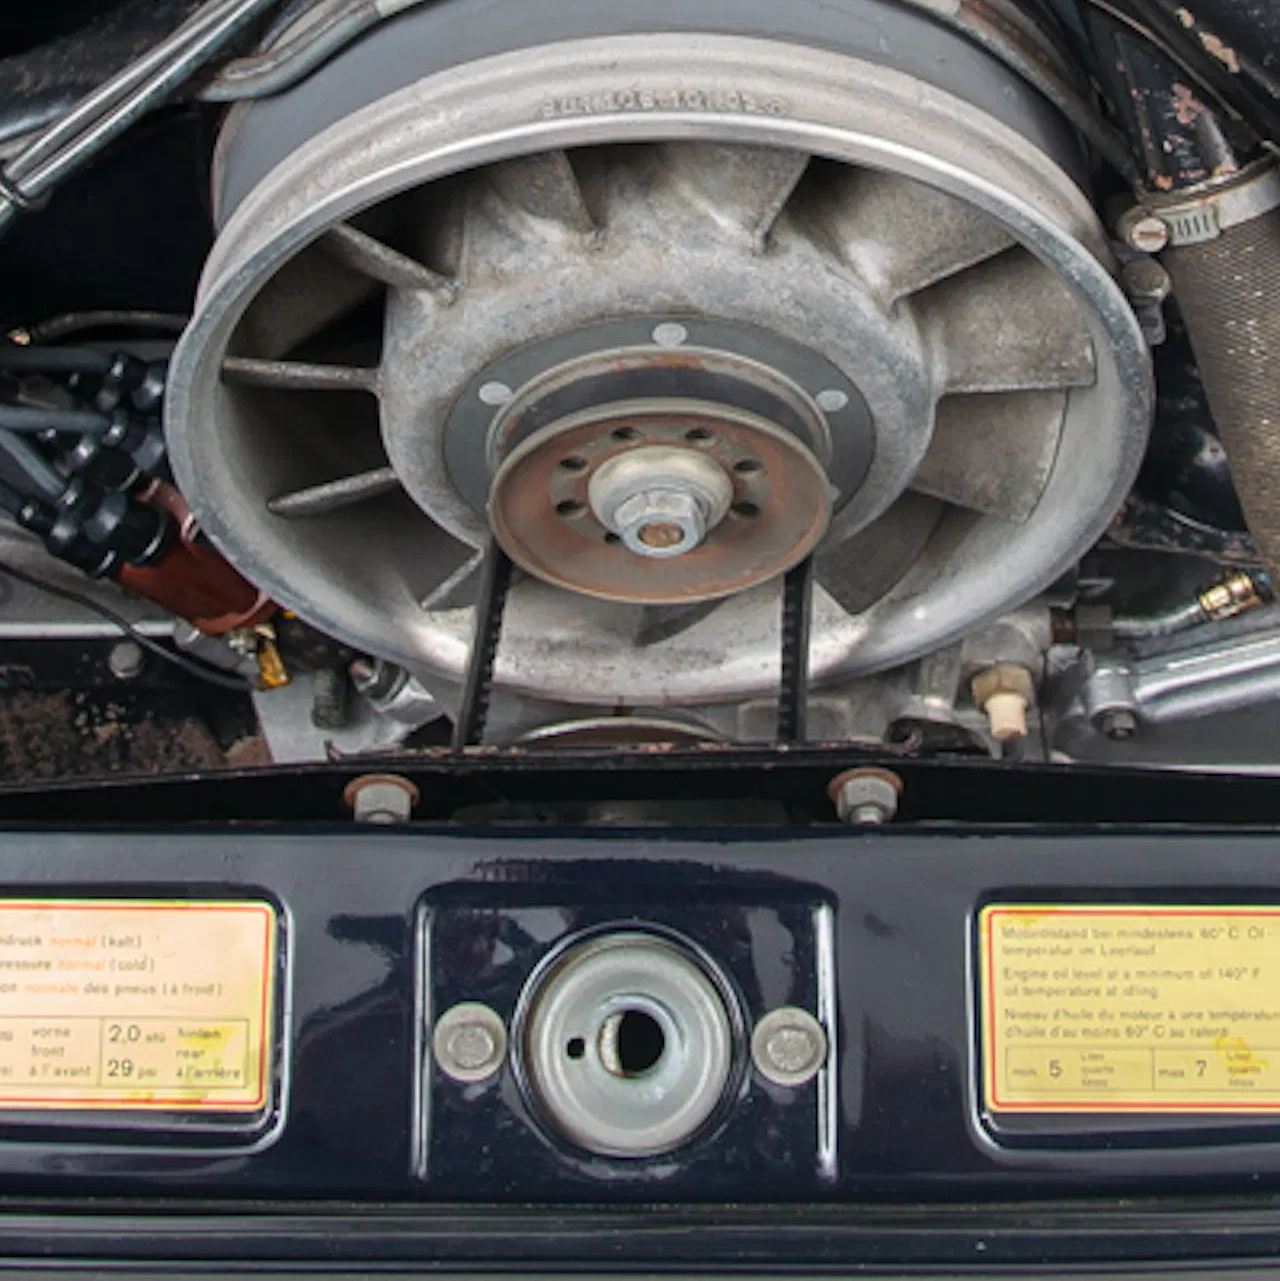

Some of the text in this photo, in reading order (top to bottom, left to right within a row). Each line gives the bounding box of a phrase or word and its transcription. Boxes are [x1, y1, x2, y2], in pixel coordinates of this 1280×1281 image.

[108, 1023, 142, 1047] 2,0
[107, 1057, 135, 1079] 29
[1048, 1059, 1064, 1081] 5
